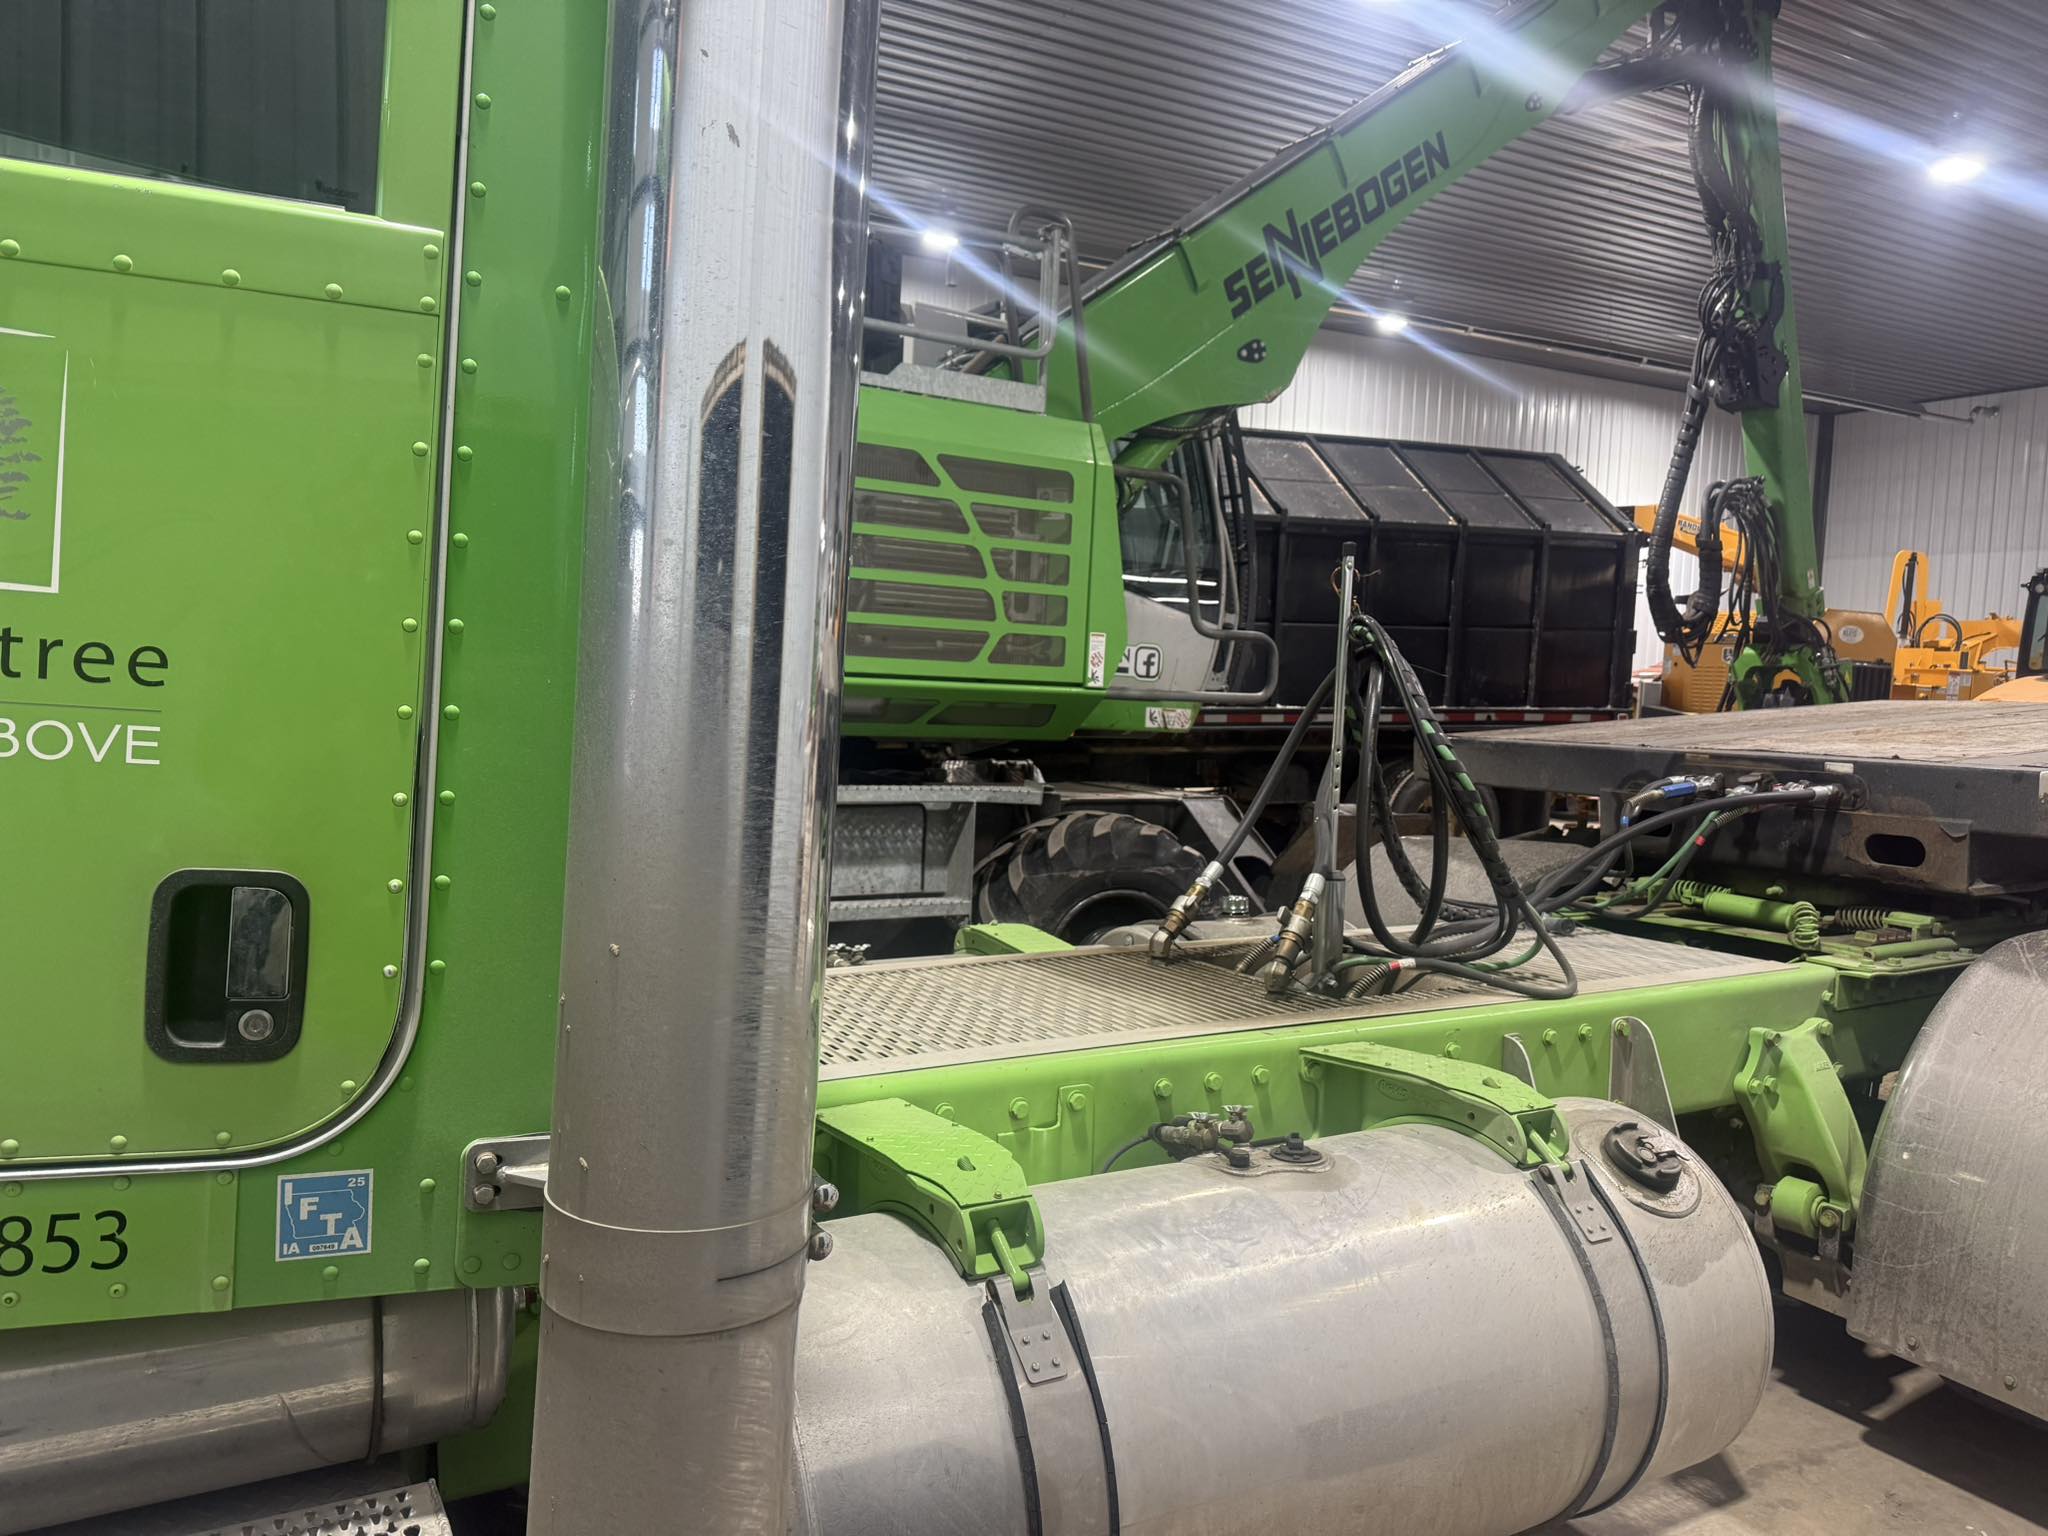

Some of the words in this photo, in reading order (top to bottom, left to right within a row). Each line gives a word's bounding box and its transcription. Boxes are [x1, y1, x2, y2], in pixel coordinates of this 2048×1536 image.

[1223, 129, 1450, 320] SENNEBOGEN
[0, 627, 169, 687] tree
[347, 1177, 365, 1188] 25
[0, 1209, 128, 1277] 853
[283, 1242, 300, 1255] IA
